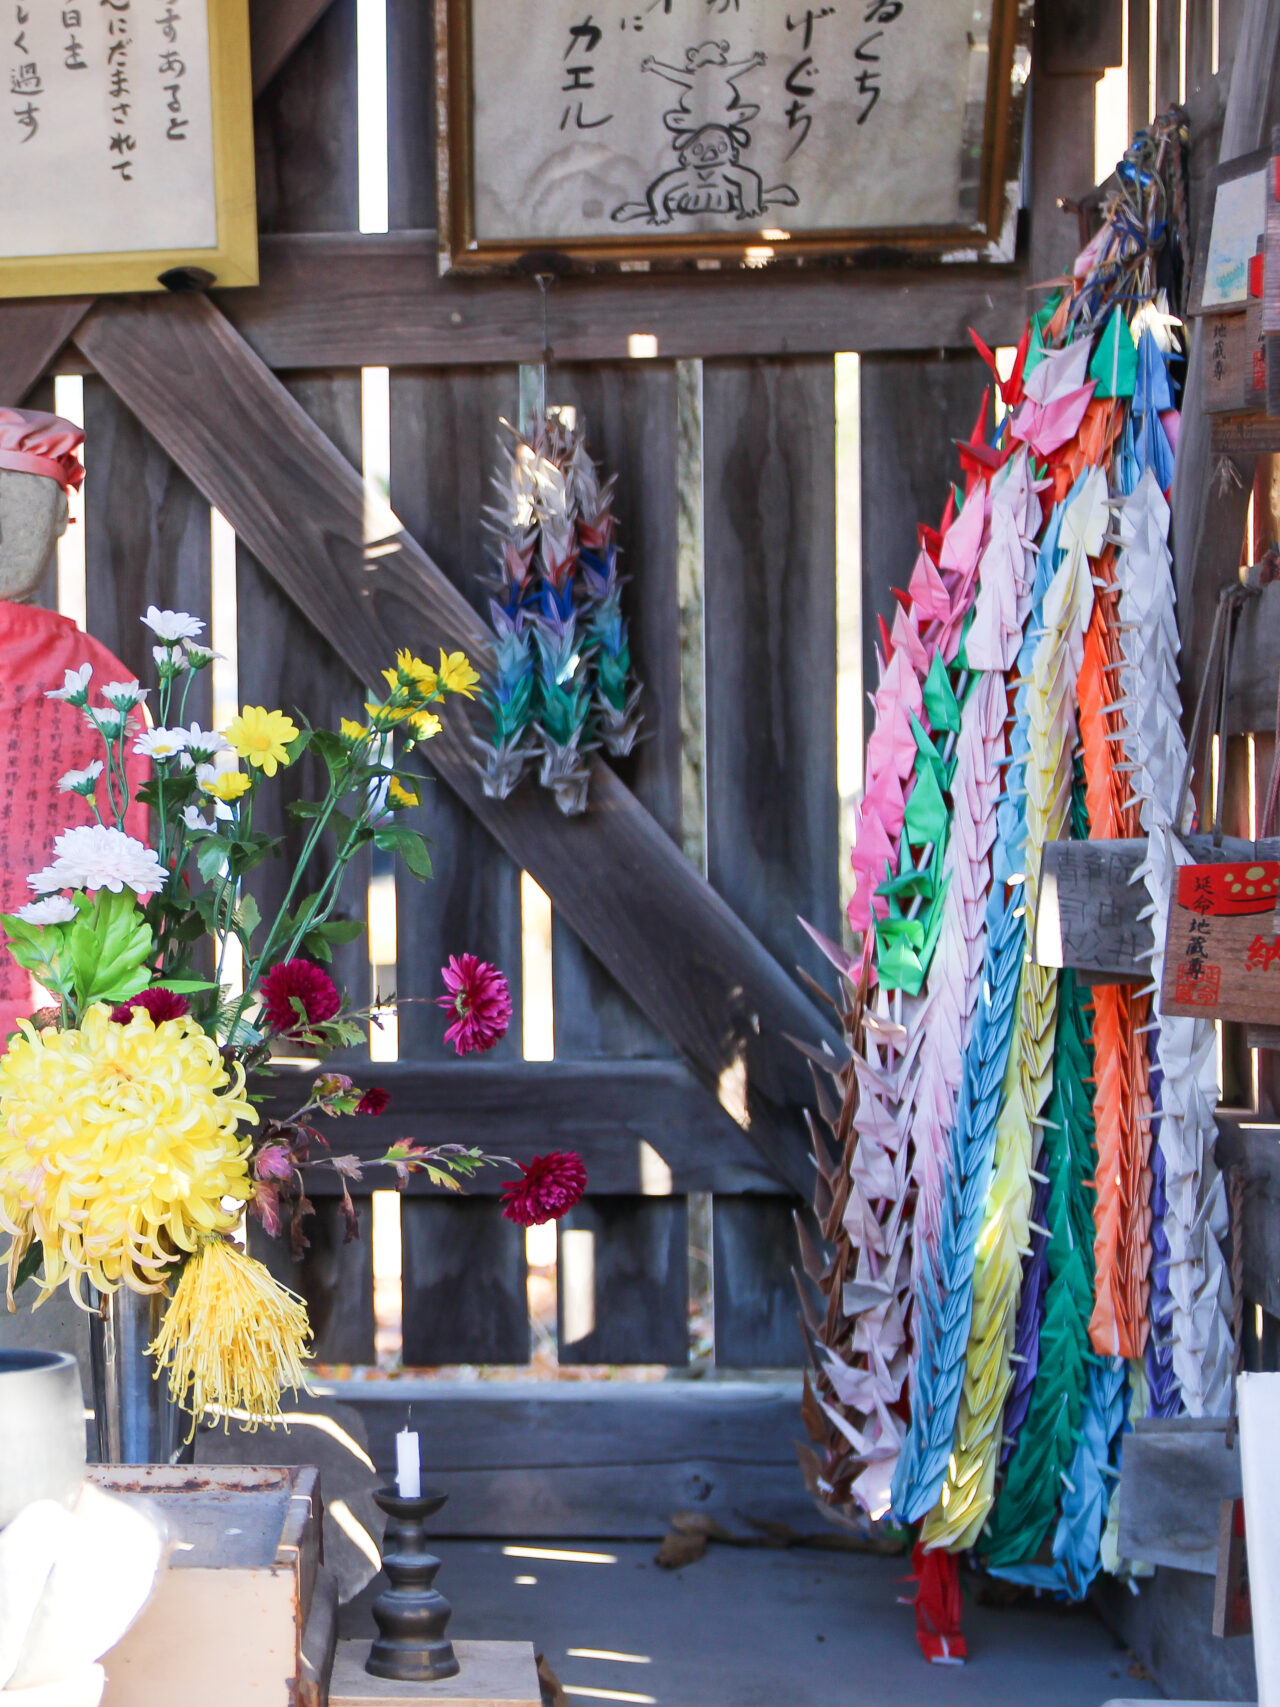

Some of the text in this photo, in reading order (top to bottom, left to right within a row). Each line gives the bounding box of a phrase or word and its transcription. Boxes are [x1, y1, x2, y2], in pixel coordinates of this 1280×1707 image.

[10, 0, 44, 144] しく過す
[154, 0, 189, 141] すあると
[560, 16, 613, 130] カエル
[1184, 875, 1215, 981] 延命地蔵尊
